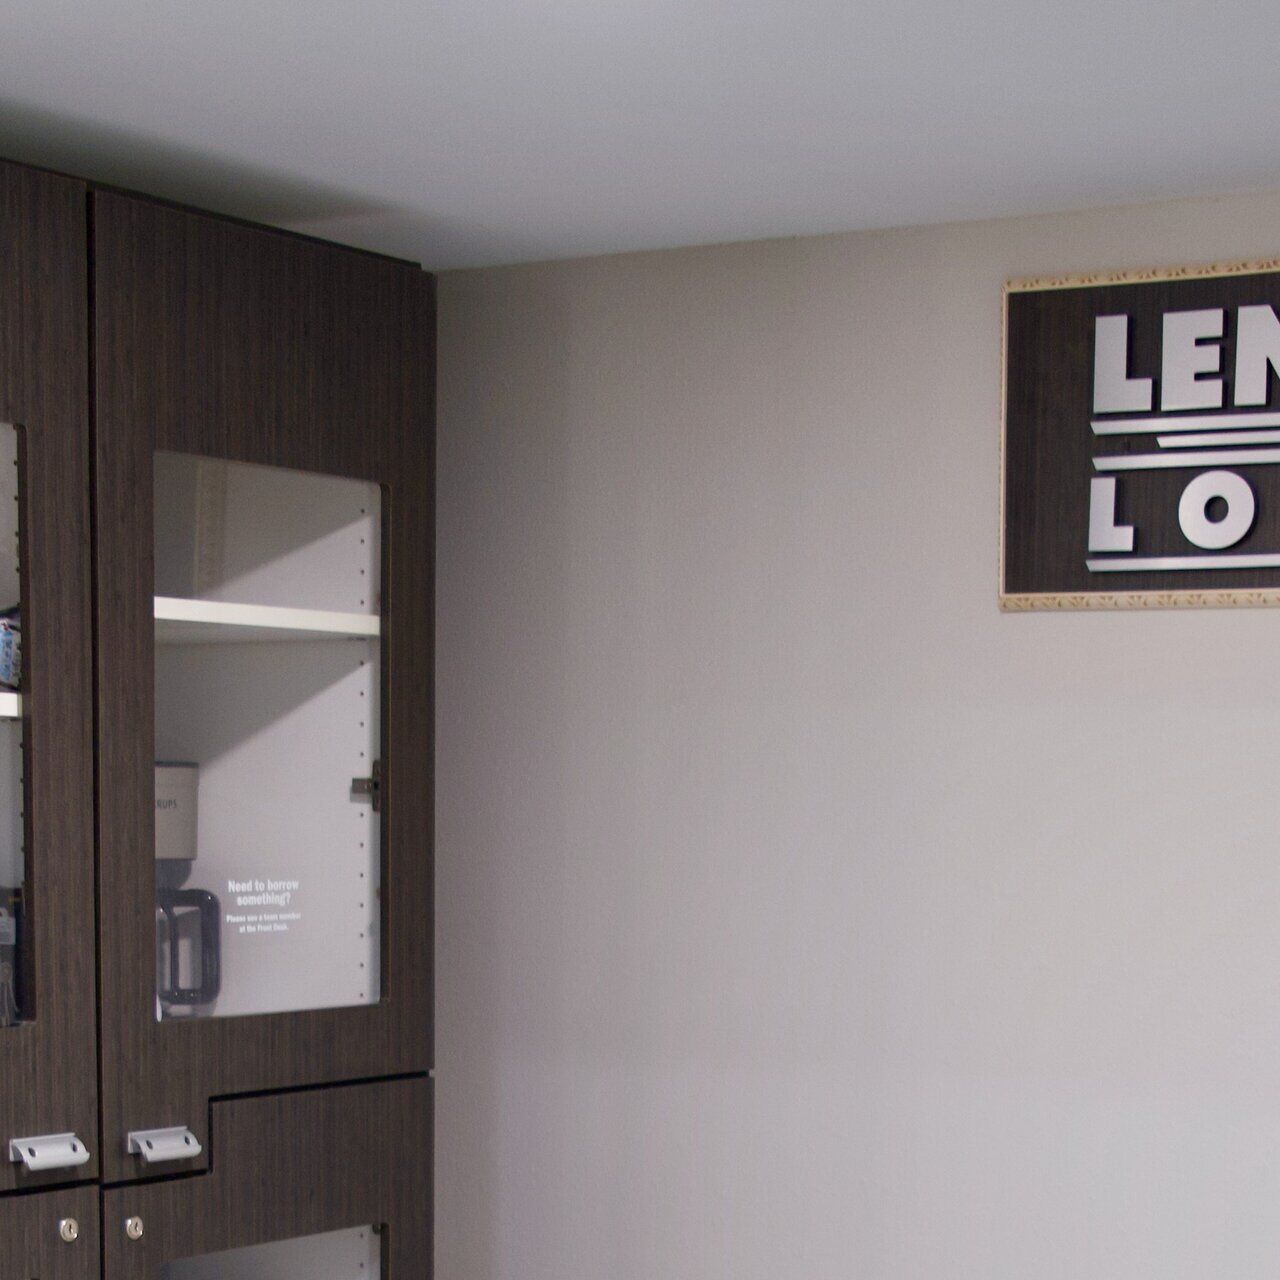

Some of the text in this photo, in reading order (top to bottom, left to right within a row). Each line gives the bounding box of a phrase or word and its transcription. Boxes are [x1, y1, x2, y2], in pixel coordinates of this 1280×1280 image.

[228, 879, 299, 893] Need to borrow
[236, 891, 291, 907] something?
